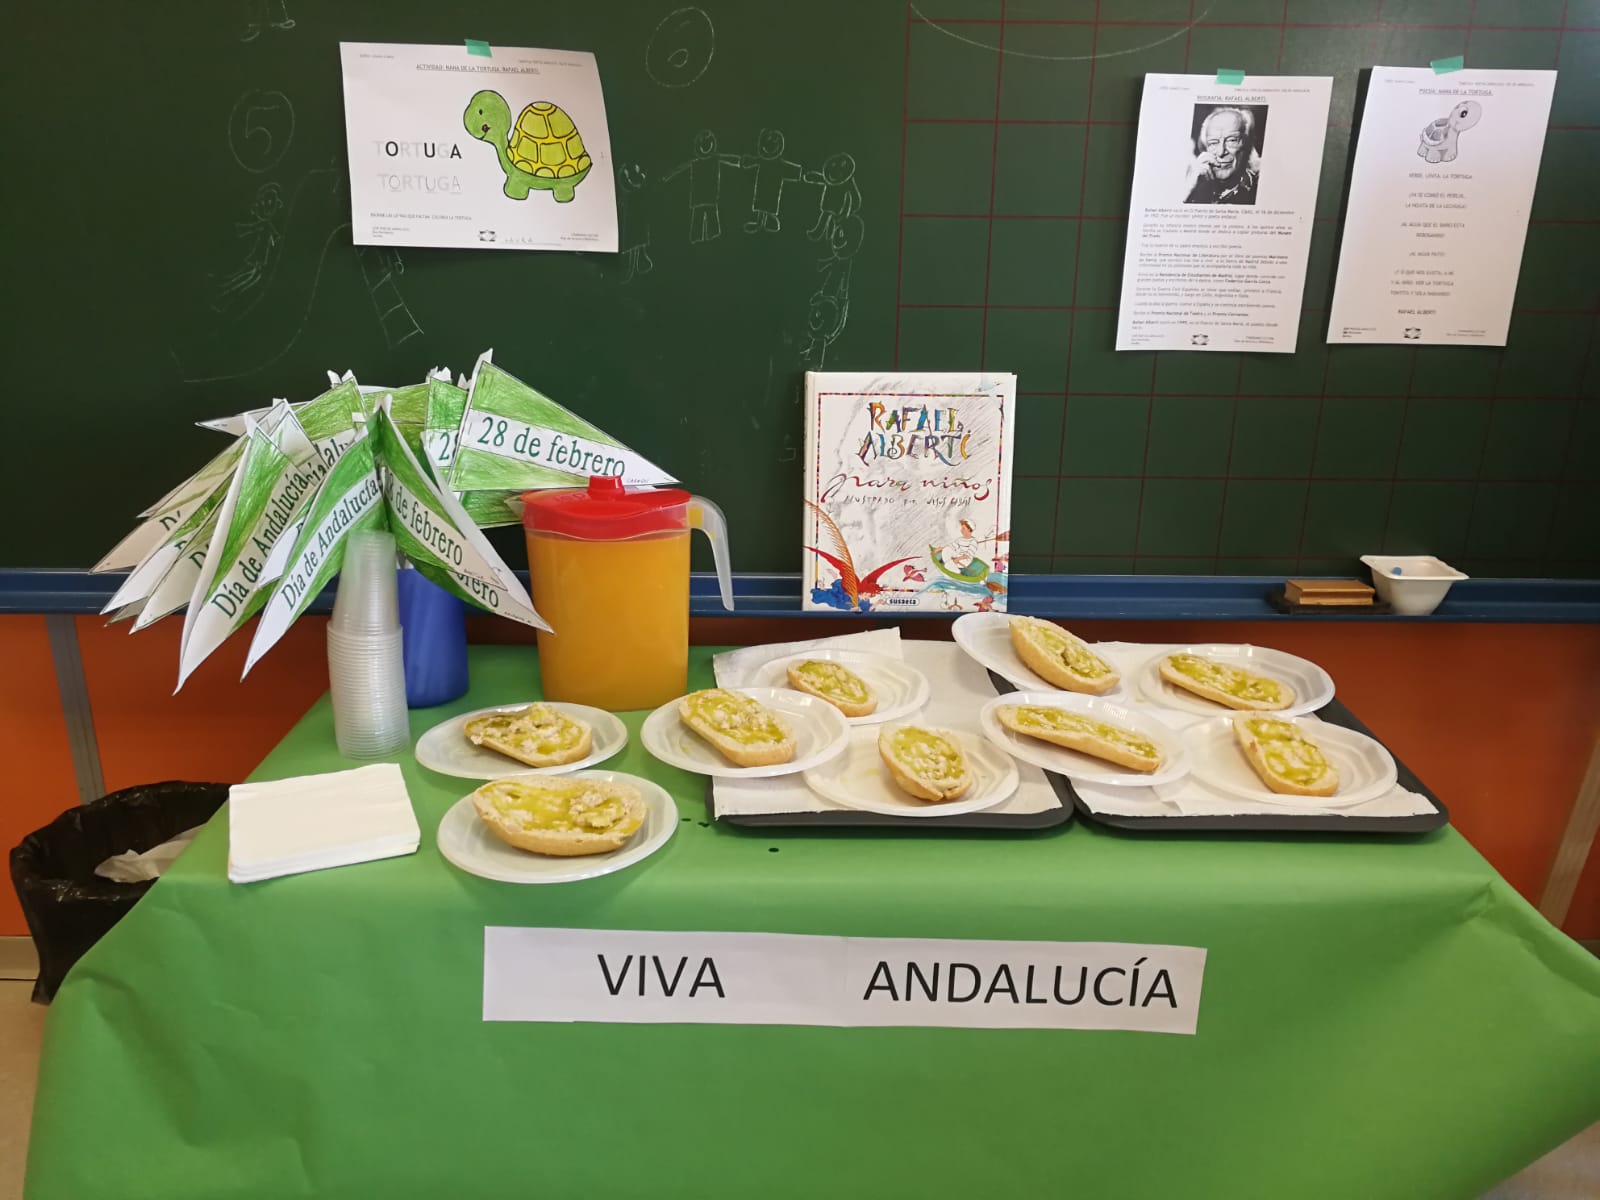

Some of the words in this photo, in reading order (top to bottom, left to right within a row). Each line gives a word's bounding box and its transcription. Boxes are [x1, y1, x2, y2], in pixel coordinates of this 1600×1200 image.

[245, 105, 279, 155] 5
[867, 401, 964, 435] RAFAEL
[477, 416, 508, 448] 28
[513, 426, 542, 458] de
[546, 434, 626, 477] febrero
[857, 430, 972, 467] ALBERTI
[922, 473, 993, 501] niños
[211, 583, 250, 619] Día
[238, 557, 263, 585] de
[252, 473, 310, 559] Andalucía
[280, 573, 306, 612] Día
[304, 552, 319, 578] de
[317, 479, 379, 558] Andalucía
[395, 486, 408, 520] de
[410, 501, 463, 566] febrero
[597, 953, 725, 998] VIVA
[863, 957, 1179, 1009] ANDALUCÍA
